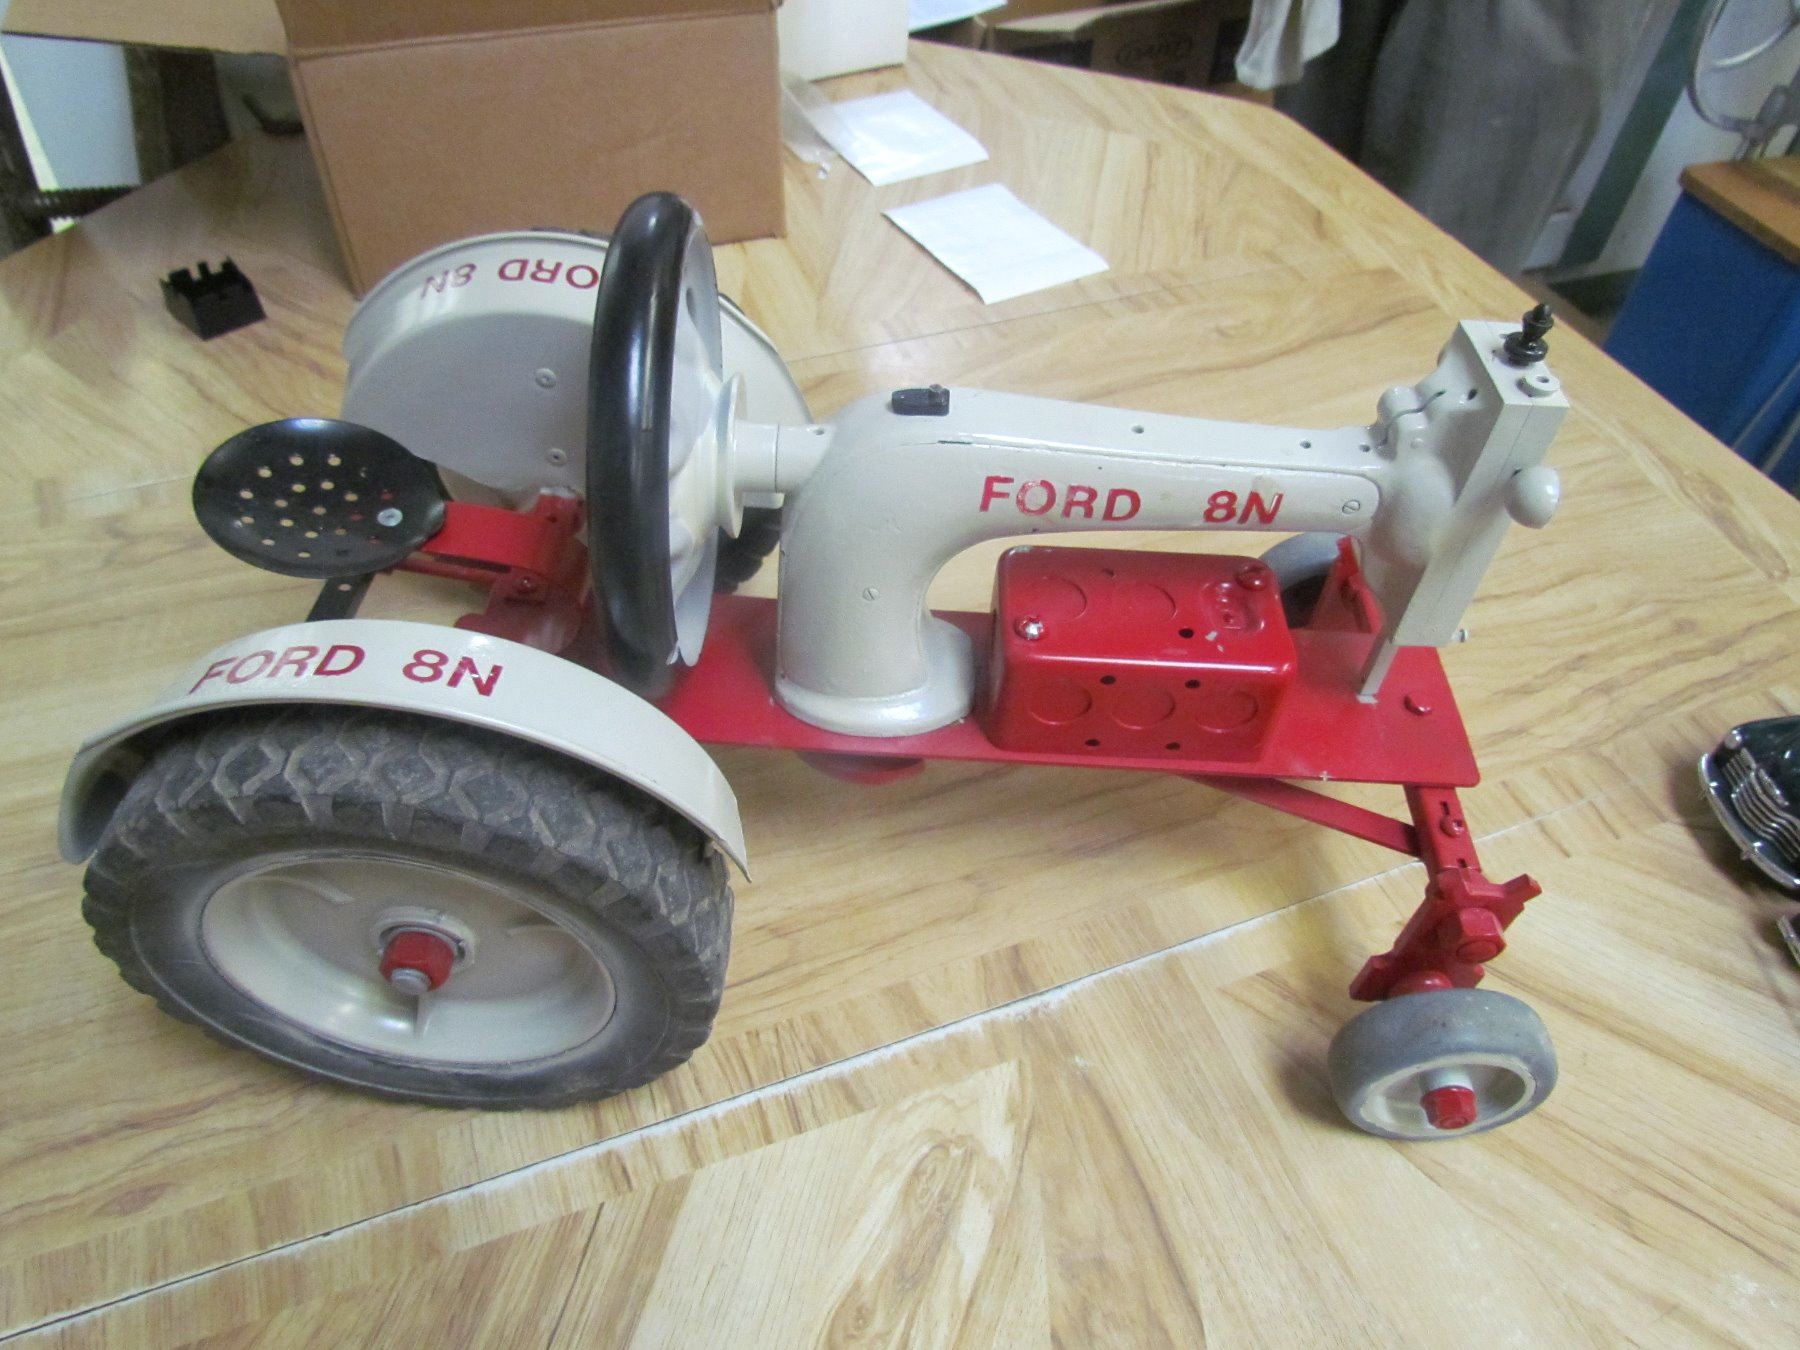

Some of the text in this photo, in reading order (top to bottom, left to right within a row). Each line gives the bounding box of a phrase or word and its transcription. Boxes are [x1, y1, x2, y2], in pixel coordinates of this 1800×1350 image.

[420, 258, 600, 300] ORD 8N
[979, 475, 1285, 525] FORD 8N
[188, 644, 503, 697] FORD 8N
